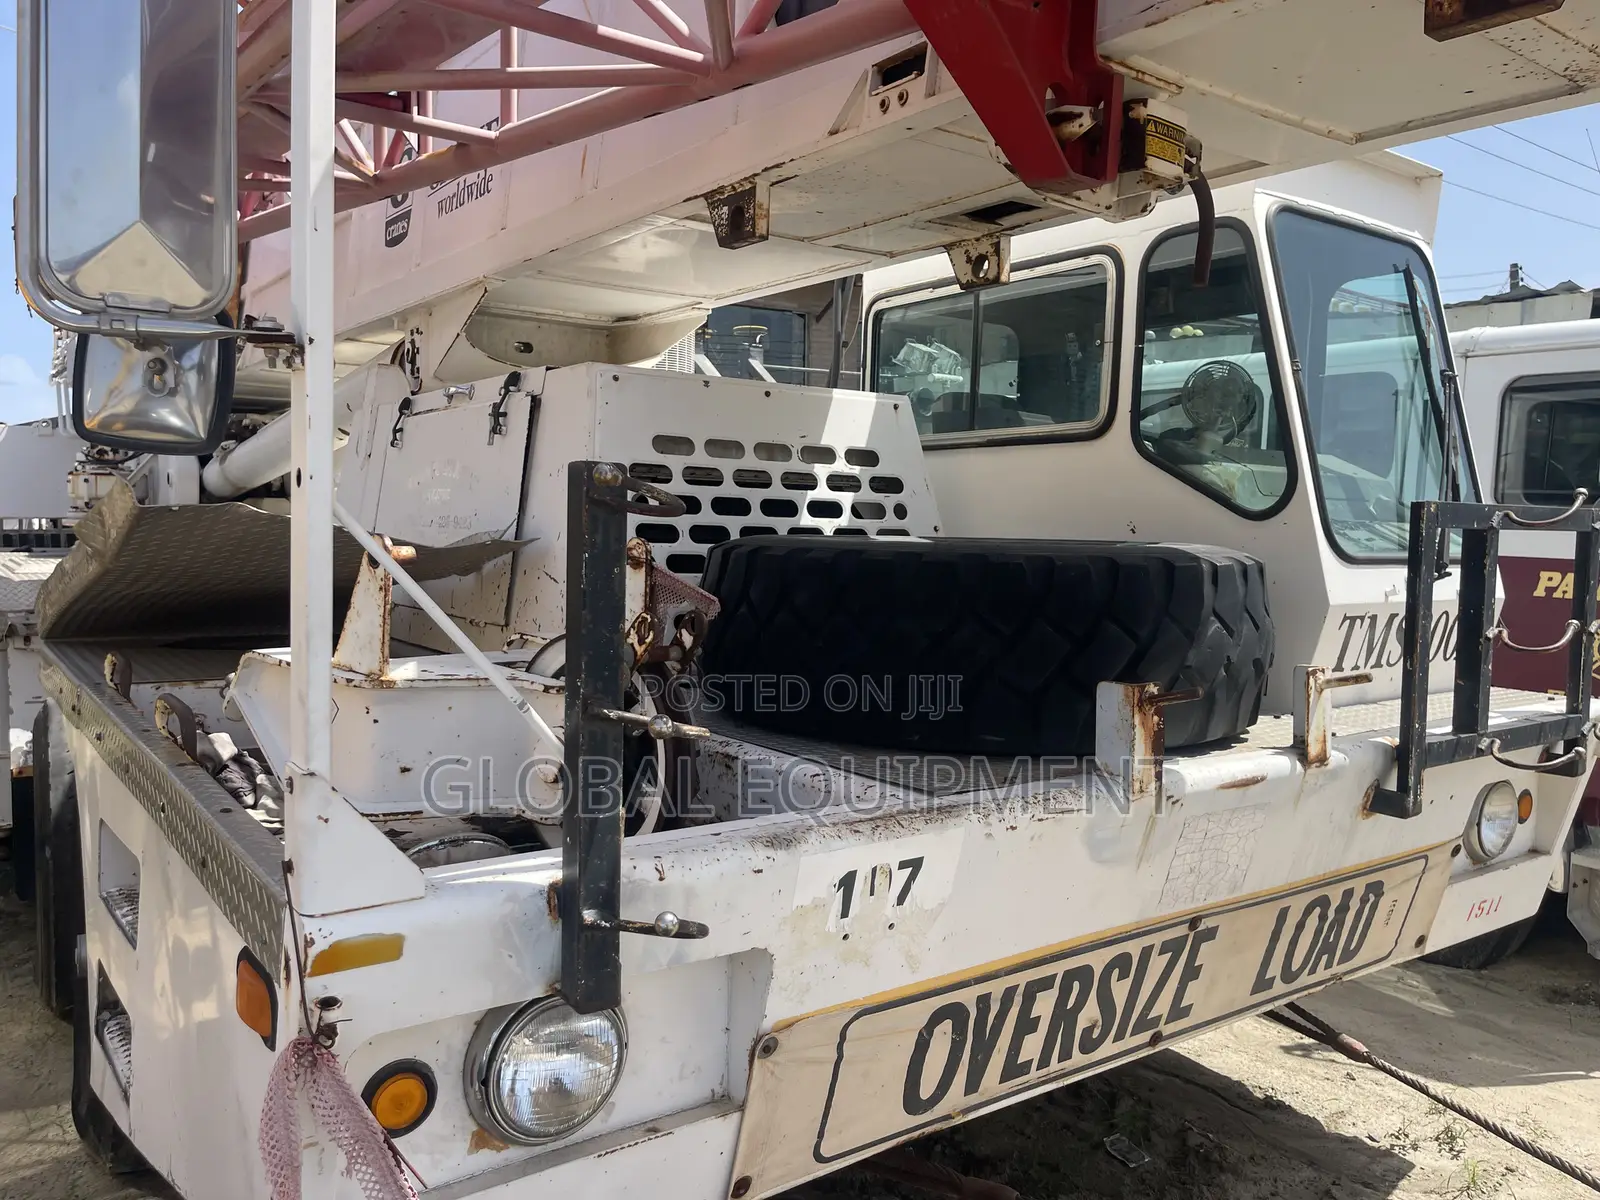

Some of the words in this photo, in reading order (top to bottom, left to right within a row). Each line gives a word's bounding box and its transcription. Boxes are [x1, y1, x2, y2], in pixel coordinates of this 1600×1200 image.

[437, 169, 493, 219] worldwide
[386, 218, 409, 241] cranes
[1332, 610, 1460, 673] TMS00
[1466, 895, 1503, 922] 1511
[902, 924, 1220, 1117] OVERSIZE
[1250, 879, 1386, 997] LOAD
